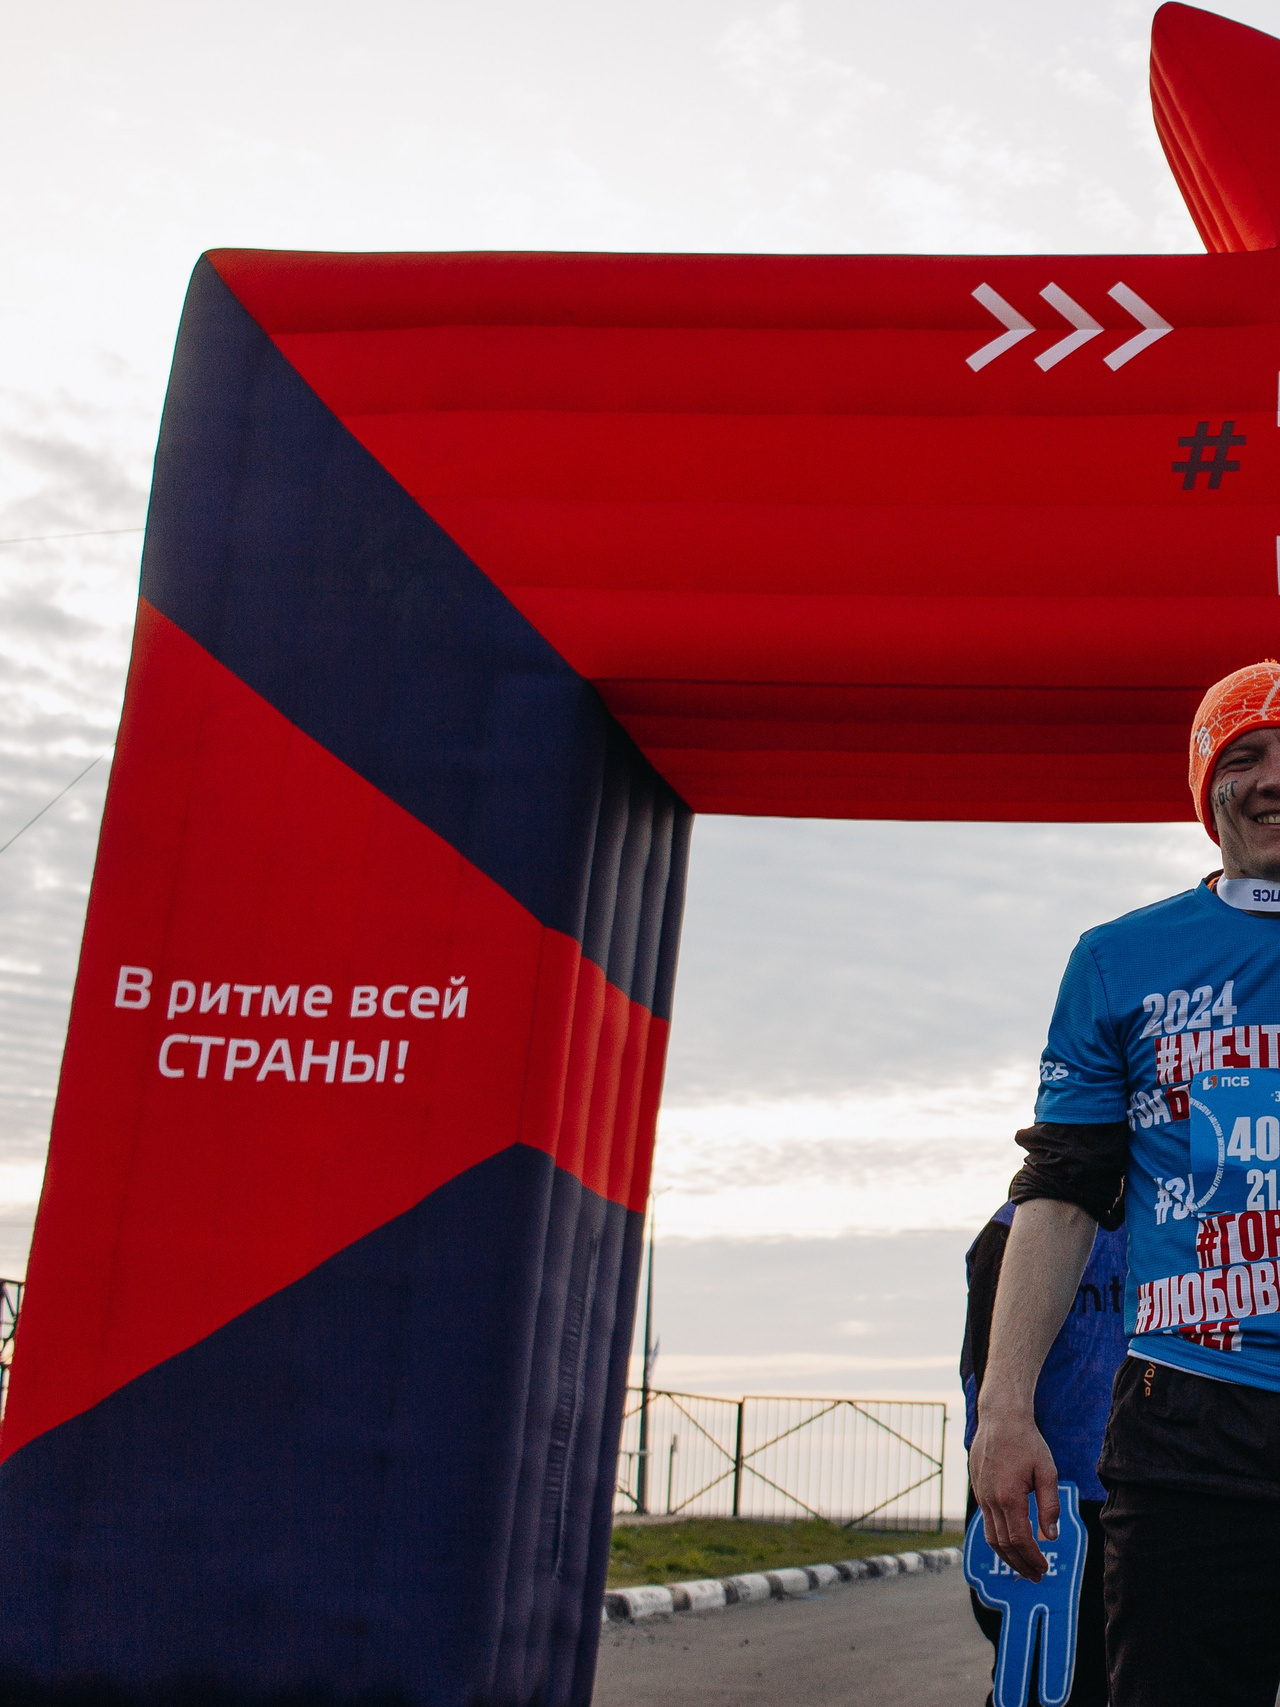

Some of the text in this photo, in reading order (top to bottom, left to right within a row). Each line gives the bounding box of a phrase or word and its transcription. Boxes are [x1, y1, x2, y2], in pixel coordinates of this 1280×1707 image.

[114, 965, 469, 1020] В ритме всей
[1139, 980, 1237, 1039] 2024
[158, 1033, 409, 1085] СТРАНЫ!
[1221, 1076, 1250, 1087] ПСБ
